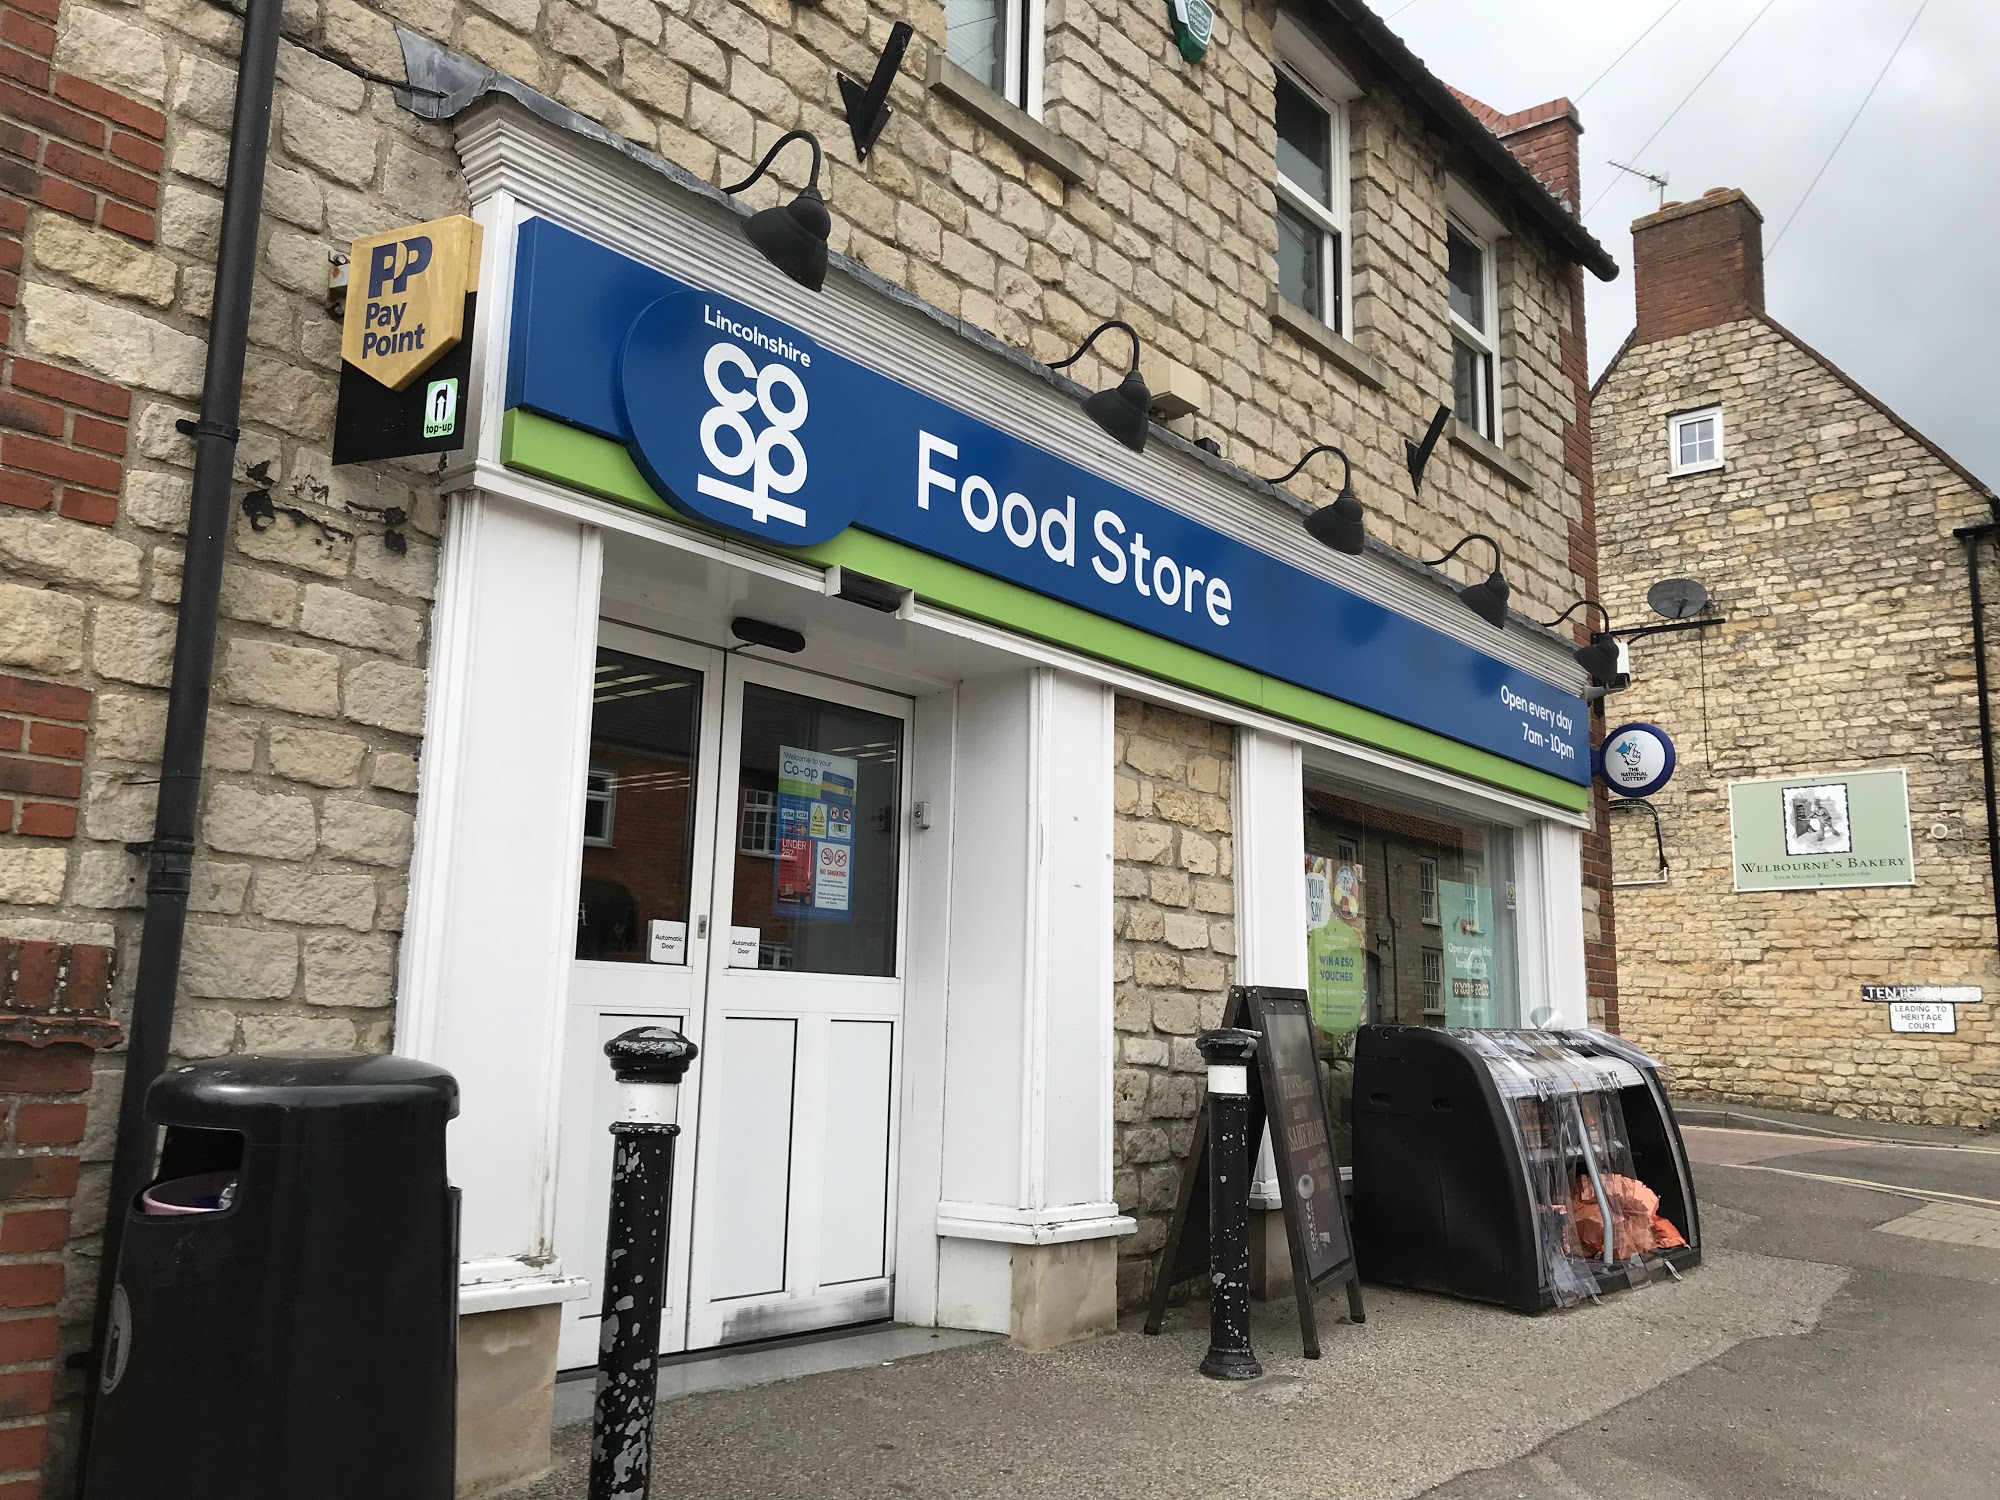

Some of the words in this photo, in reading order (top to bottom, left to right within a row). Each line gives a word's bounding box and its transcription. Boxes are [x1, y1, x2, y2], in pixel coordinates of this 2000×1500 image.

[365, 301, 408, 333] Pay
[361, 322, 426, 360] Point
[703, 304, 812, 368] Lincolnshire
[425, 422, 453, 435] top-up
[917, 429, 1076, 568] Food
[1091, 509, 1233, 627] Store
[1500, 684, 1528, 713] Open
[1528, 701, 1556, 729] every
[1556, 710, 1573, 736] day
[1521, 721, 1544, 748] 7am
[1549, 733, 1575, 760] 10pm
[783, 751, 812, 764] Welcome
[783, 760, 819, 781] Co-op
[782, 838, 807, 851] UNDER
[1847, 856, 1906, 869] BAKERY
[827, 869, 847, 878] SMOKING
[1307, 878, 1325, 900] YOUR
[1310, 900, 1323, 922] SAY
[654, 933, 683, 942] Automatic
[731, 939, 757, 947] Automatic
[737, 947, 750, 955] Door
[1447, 942, 1464, 956] Open
[1319, 955, 1334, 966] WIN
[1334, 958, 1340, 967] A
[1340, 957, 1354, 968] £50
[1319, 969, 1354, 982] VOUCHER
[1894, 1005, 1931, 1013] LEADING
[1936, 1005, 1947, 1013] TO
[1900, 1013, 1943, 1021] HERITAGE
[1908, 1022, 1936, 1030] COURT
